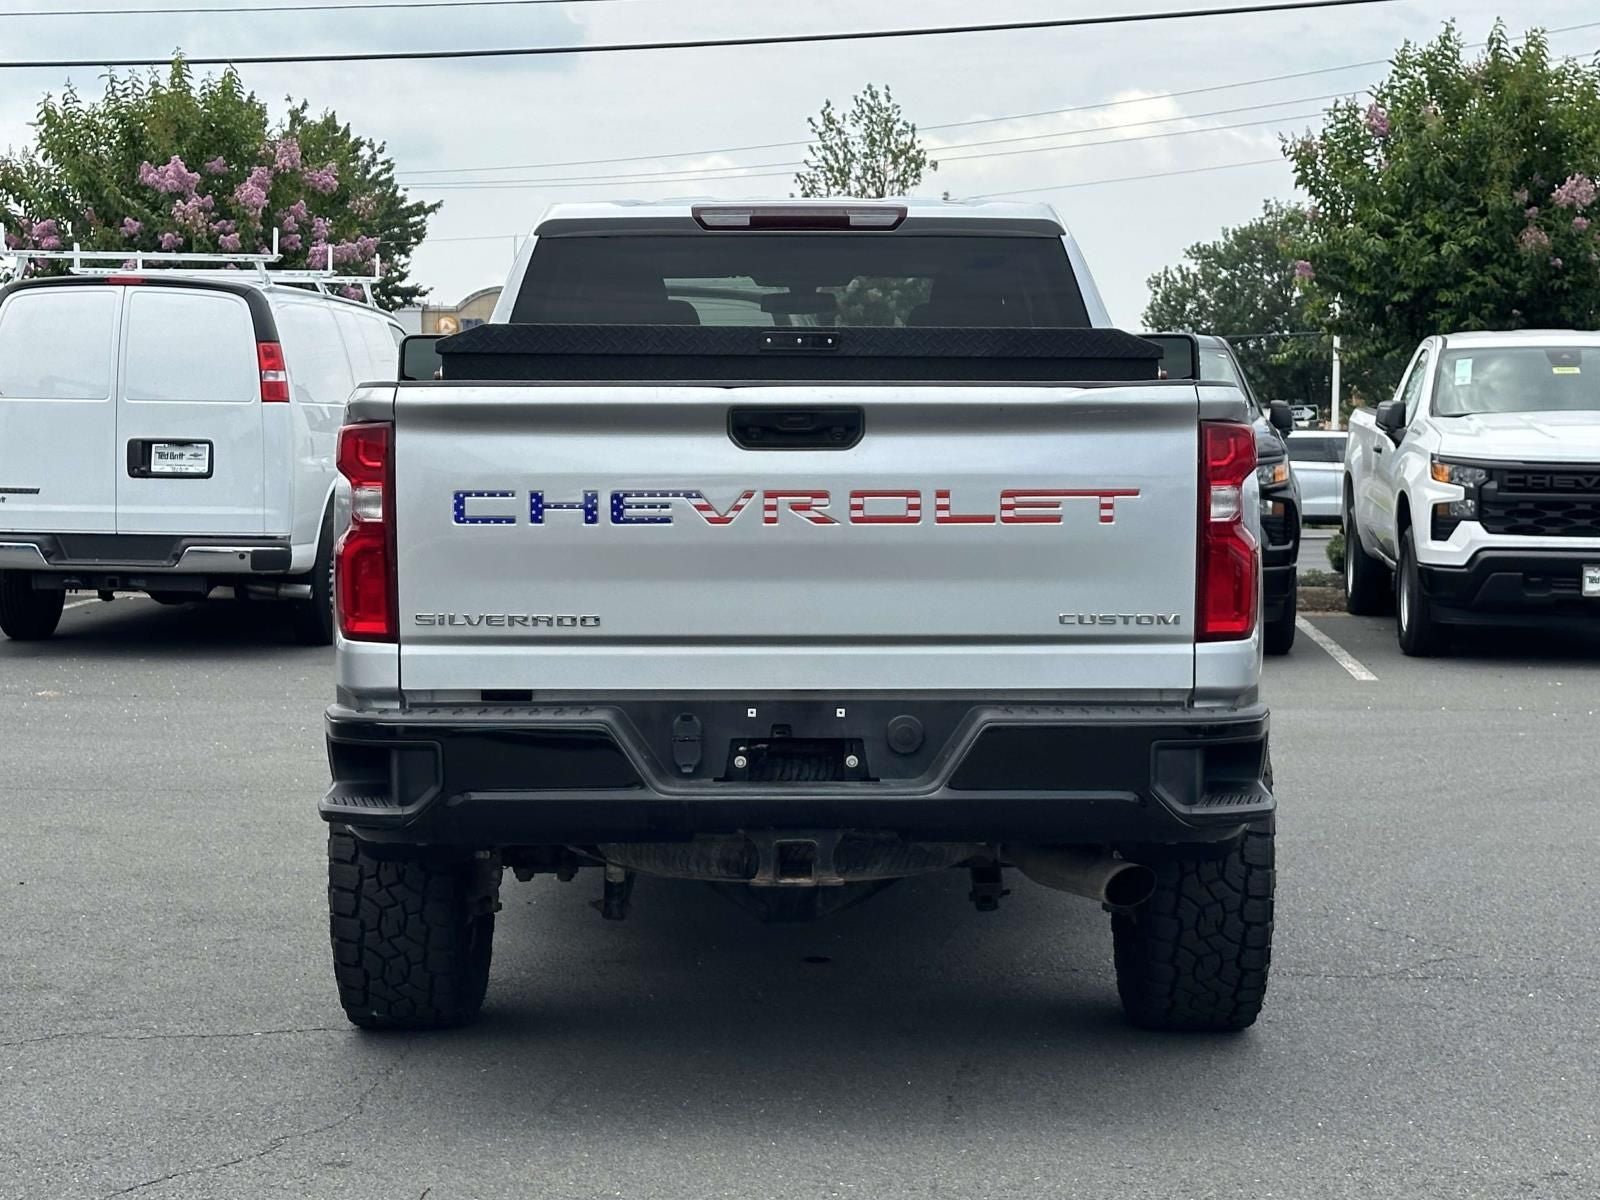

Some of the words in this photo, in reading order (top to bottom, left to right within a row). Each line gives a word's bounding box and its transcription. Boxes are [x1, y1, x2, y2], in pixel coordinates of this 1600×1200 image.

[155, 451, 169, 460] Ted
[452, 489, 1141, 525] CHEVROLET
[414, 612, 601, 627] SILVERADO
[1058, 613, 1181, 626] CUSTOM
